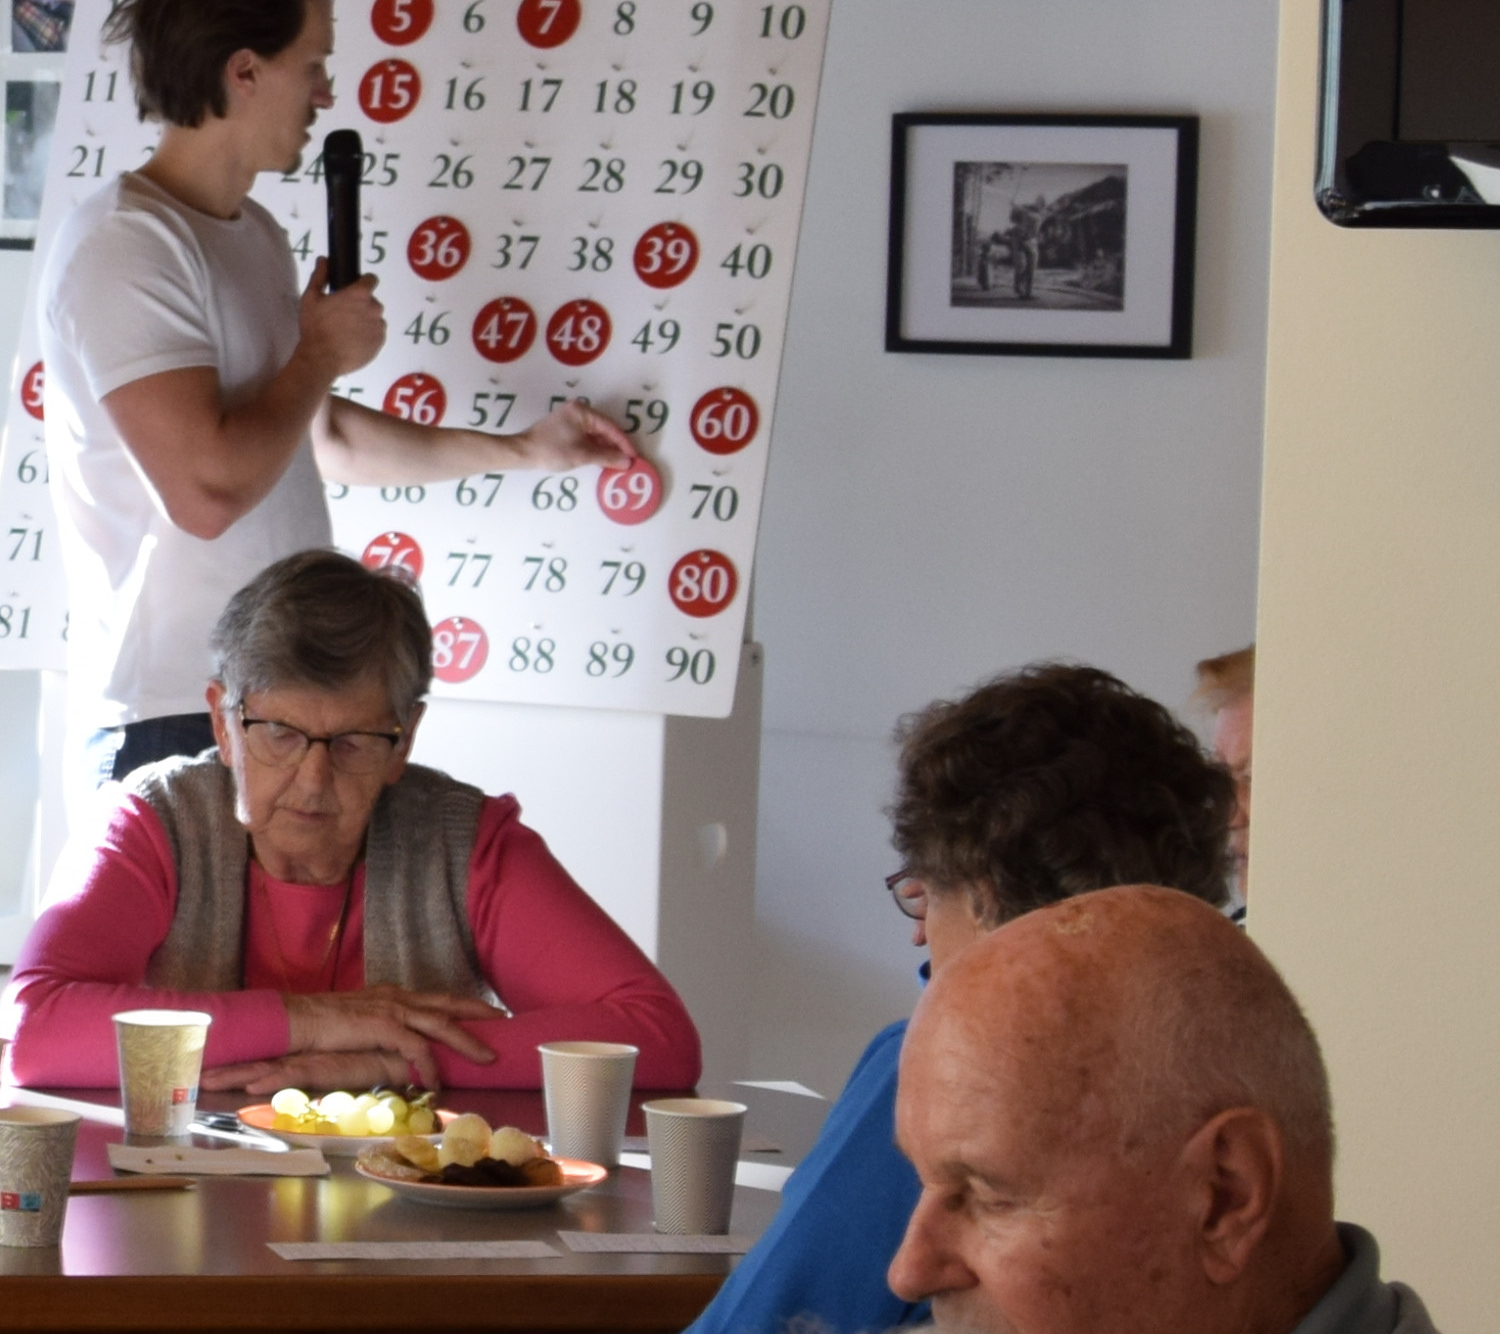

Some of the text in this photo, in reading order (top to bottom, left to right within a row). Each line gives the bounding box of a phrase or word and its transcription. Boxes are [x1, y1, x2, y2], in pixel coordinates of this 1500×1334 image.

[462, 0, 485, 33] 6
[613, 1, 636, 36] 8
[690, 1, 714, 36] 9
[760, 5, 806, 40] 10
[84, 70, 118, 102] 11
[369, 74, 412, 109] 15
[445, 77, 486, 111] 16
[519, 78, 563, 113] 17
[595, 79, 637, 114] 18
[671, 80, 715, 115] 19
[743, 82, 795, 119] 20
[67, 144, 105, 178] 21
[428, 153, 474, 189] 26
[502, 155, 552, 191] 27
[577, 157, 626, 193] 28
[653, 159, 704, 195] 29
[735, 162, 784, 199] 30
[411, 229, 460, 268] 36
[491, 234, 540, 270] 37
[567, 236, 614, 272] 38
[638, 238, 692, 275] 39
[720, 243, 773, 279] 40
[404, 311, 762, 360] 46 47 48 49 50
[467, 392, 518, 428] 57
[623, 399, 669, 435] 59
[696, 402, 750, 441] 60
[455, 472, 505, 508] 67
[531, 476, 579, 511] 68
[602, 472, 653, 511] 69
[690, 483, 739, 522] 70
[9, 527, 44, 561] 71
[447, 551, 493, 588] 77
[524, 556, 568, 593] 78
[600, 560, 647, 596] 79
[676, 565, 729, 604] 80
[432, 632, 481, 669] 87
[508, 637, 556, 673] 88
[585, 642, 635, 677] 89
[665, 647, 716, 685] 90
